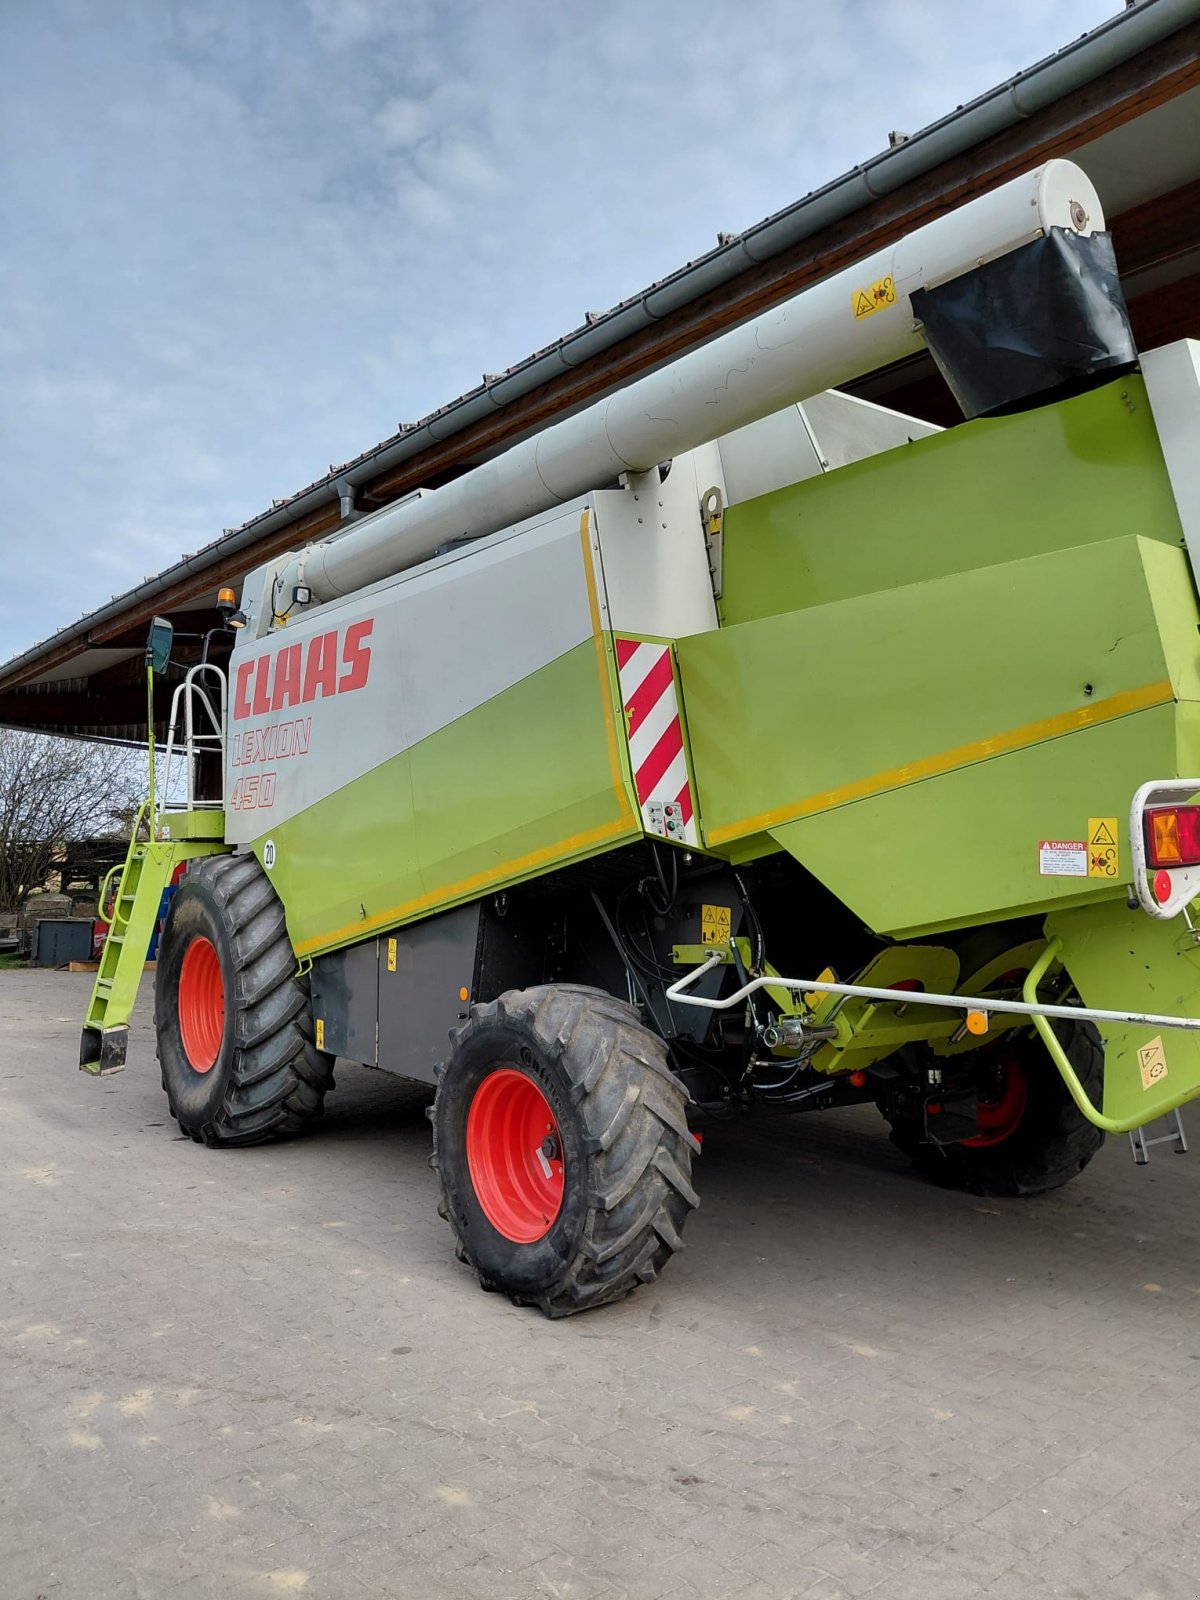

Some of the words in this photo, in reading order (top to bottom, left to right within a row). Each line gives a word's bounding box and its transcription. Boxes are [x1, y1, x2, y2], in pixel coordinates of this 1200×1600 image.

[233, 618, 374, 721] CLAAS
[231, 717, 312, 767] LEXION
[230, 772, 277, 811] 450
[265, 844, 274, 865] 20
[1052, 842, 1084, 850] DANGER
